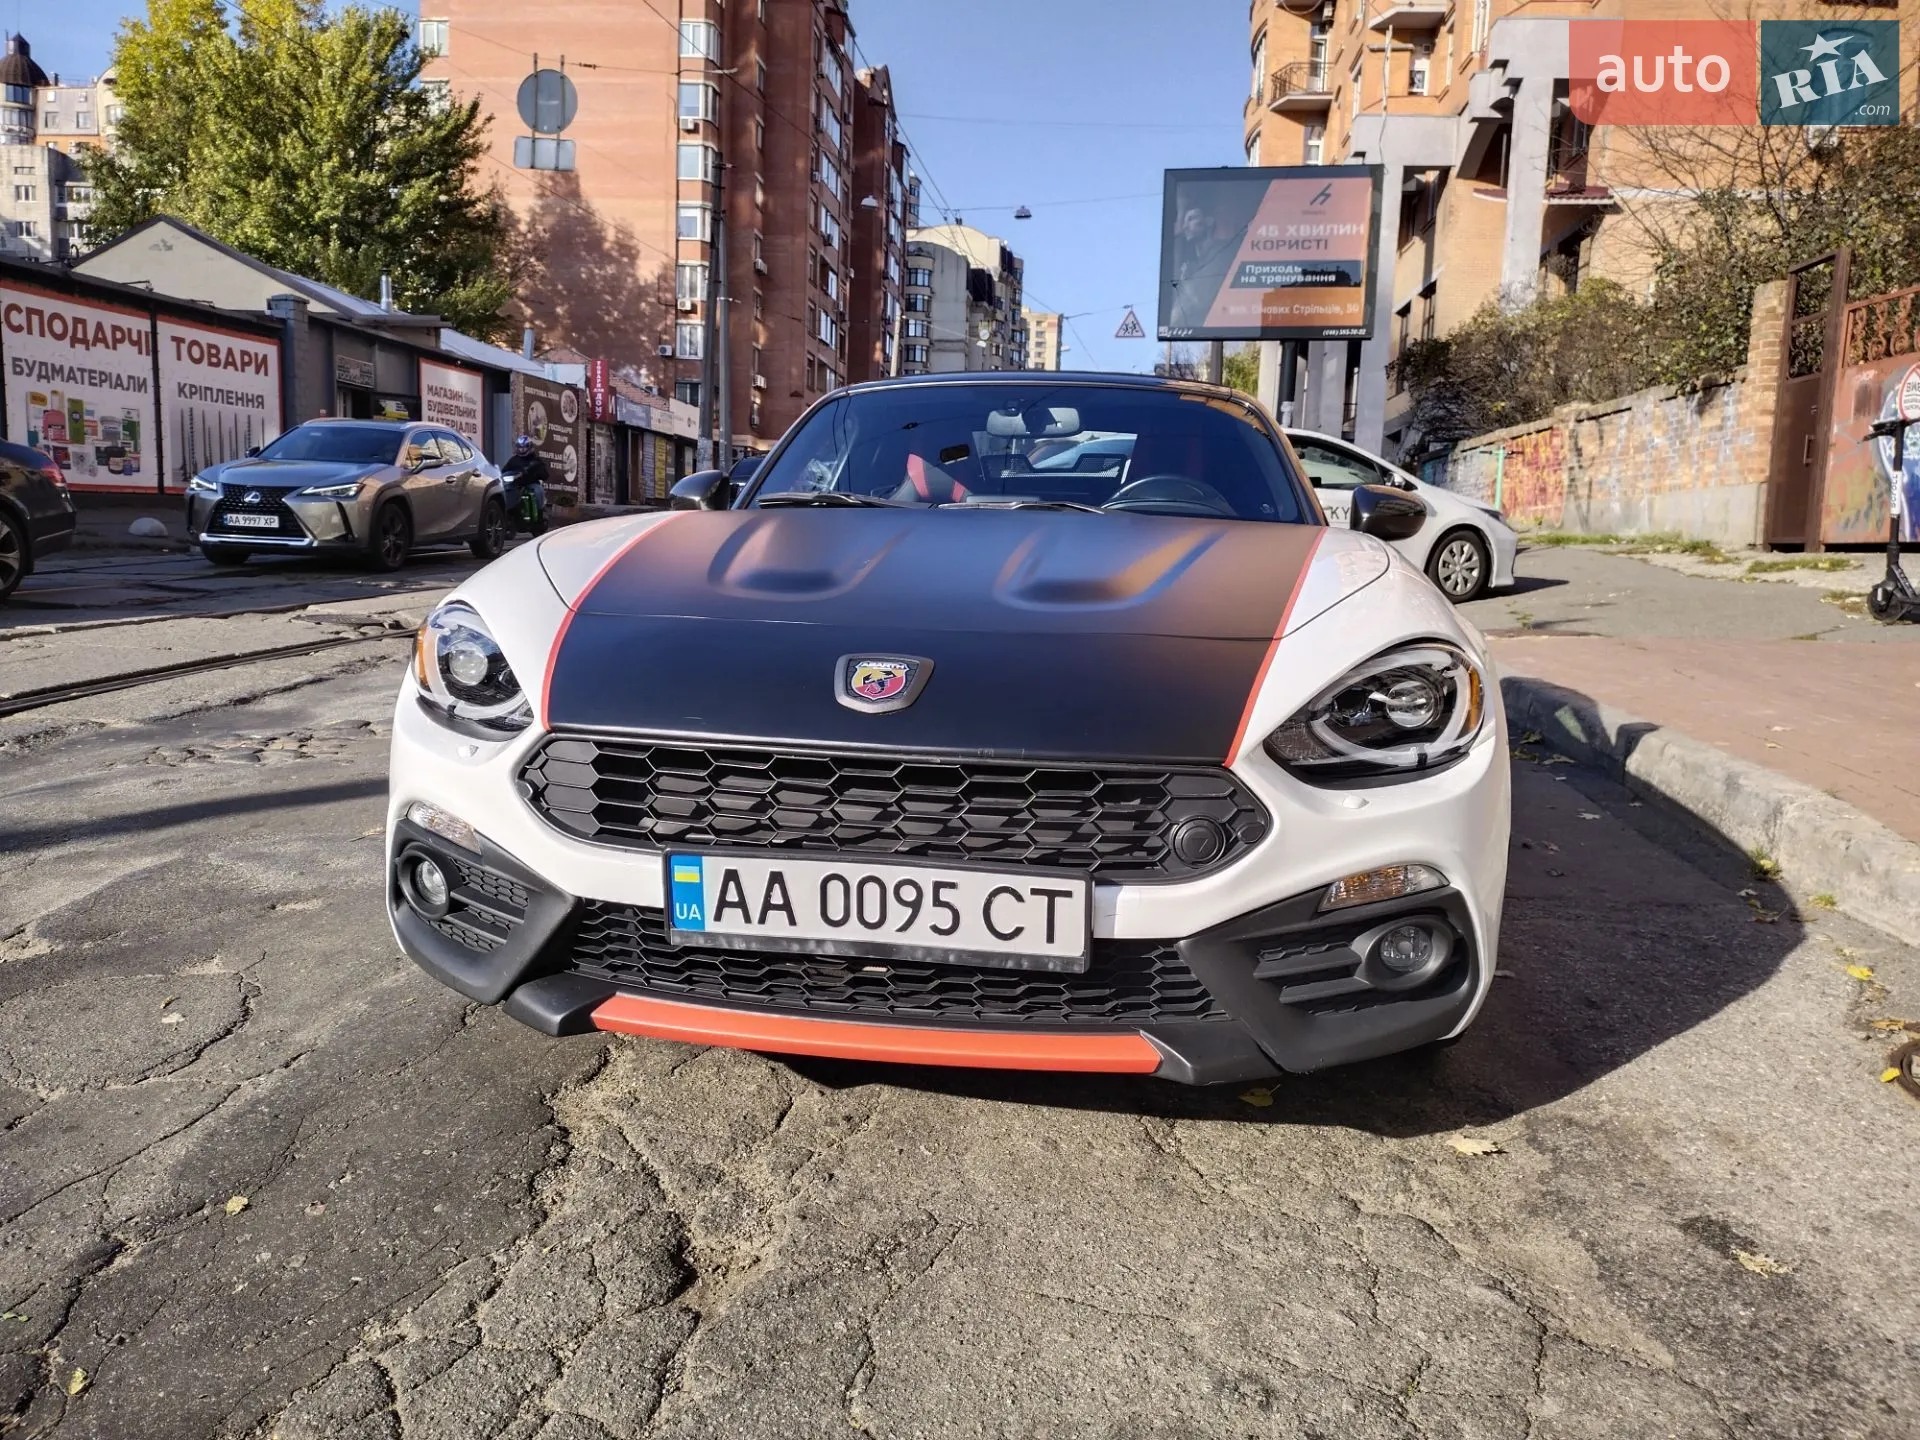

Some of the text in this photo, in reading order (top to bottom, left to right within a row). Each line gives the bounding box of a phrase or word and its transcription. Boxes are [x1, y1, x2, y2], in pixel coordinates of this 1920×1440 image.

[1256, 223, 1364, 237] 45 ХВИЛИН
[1250, 239, 1328, 251] КОРИСТІ
[1245, 264, 1302, 275] Приходь
[1240, 274, 1336, 285] на тренування
[4, 302, 269, 377] СПОДАРЧІ ТОВАРИ
[12, 356, 148, 394] БУДМАТЕРІАЛИ
[177, 381, 265, 410] КРІПЛЕННЯ
[427, 384, 463, 402] МАГАЗИН
[427, 400, 477, 419] БУДІВЕЛЬНИХ
[228, 515, 276, 526] AA 9997 XP
[861, 661, 905, 670] ABARTH
[675, 902, 702, 921] UA
[712, 868, 1074, 944] AA 0095 CT
